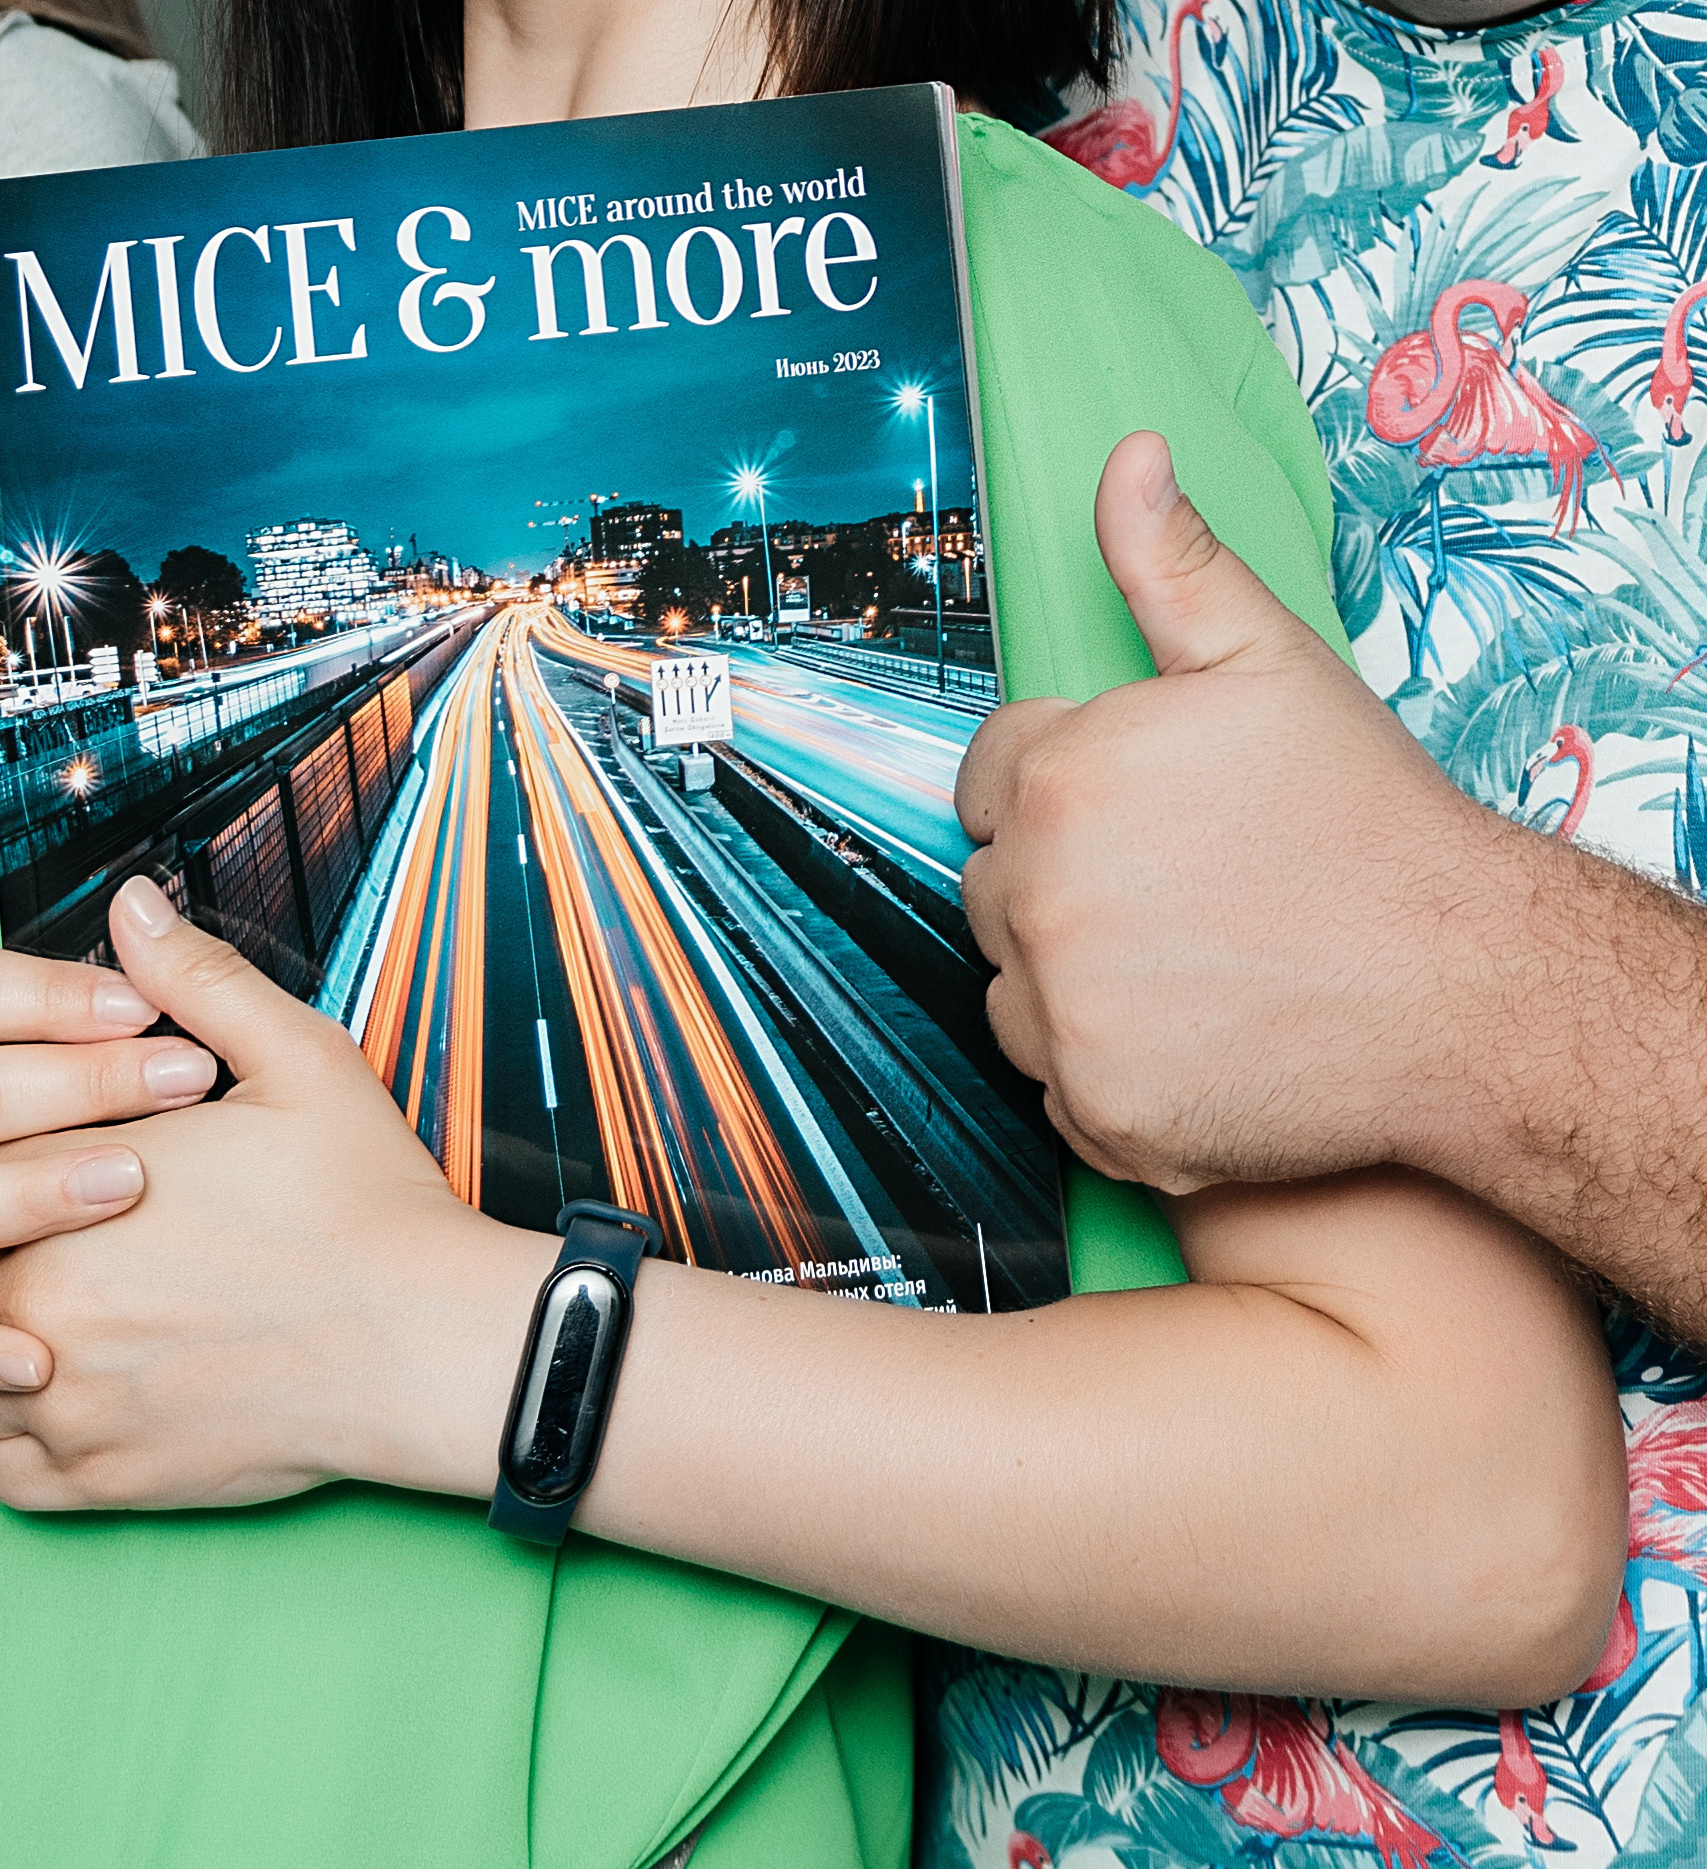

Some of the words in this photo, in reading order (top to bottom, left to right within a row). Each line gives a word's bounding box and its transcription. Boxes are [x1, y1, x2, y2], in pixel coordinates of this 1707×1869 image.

[516, 193, 598, 232] MICE
[606, 182, 715, 222] around
[721, 178, 774, 210] the
[779, 165, 867, 205] world
[3, 217, 369, 394] MICE
[395, 205, 496, 354] &
[519, 211, 879, 342] more
[775, 356, 830, 379] Июнь
[833, 348, 882, 374] 2023
[799, 1254, 903, 1280] Мальдивы:
[874, 1278, 927, 1300] отеля
